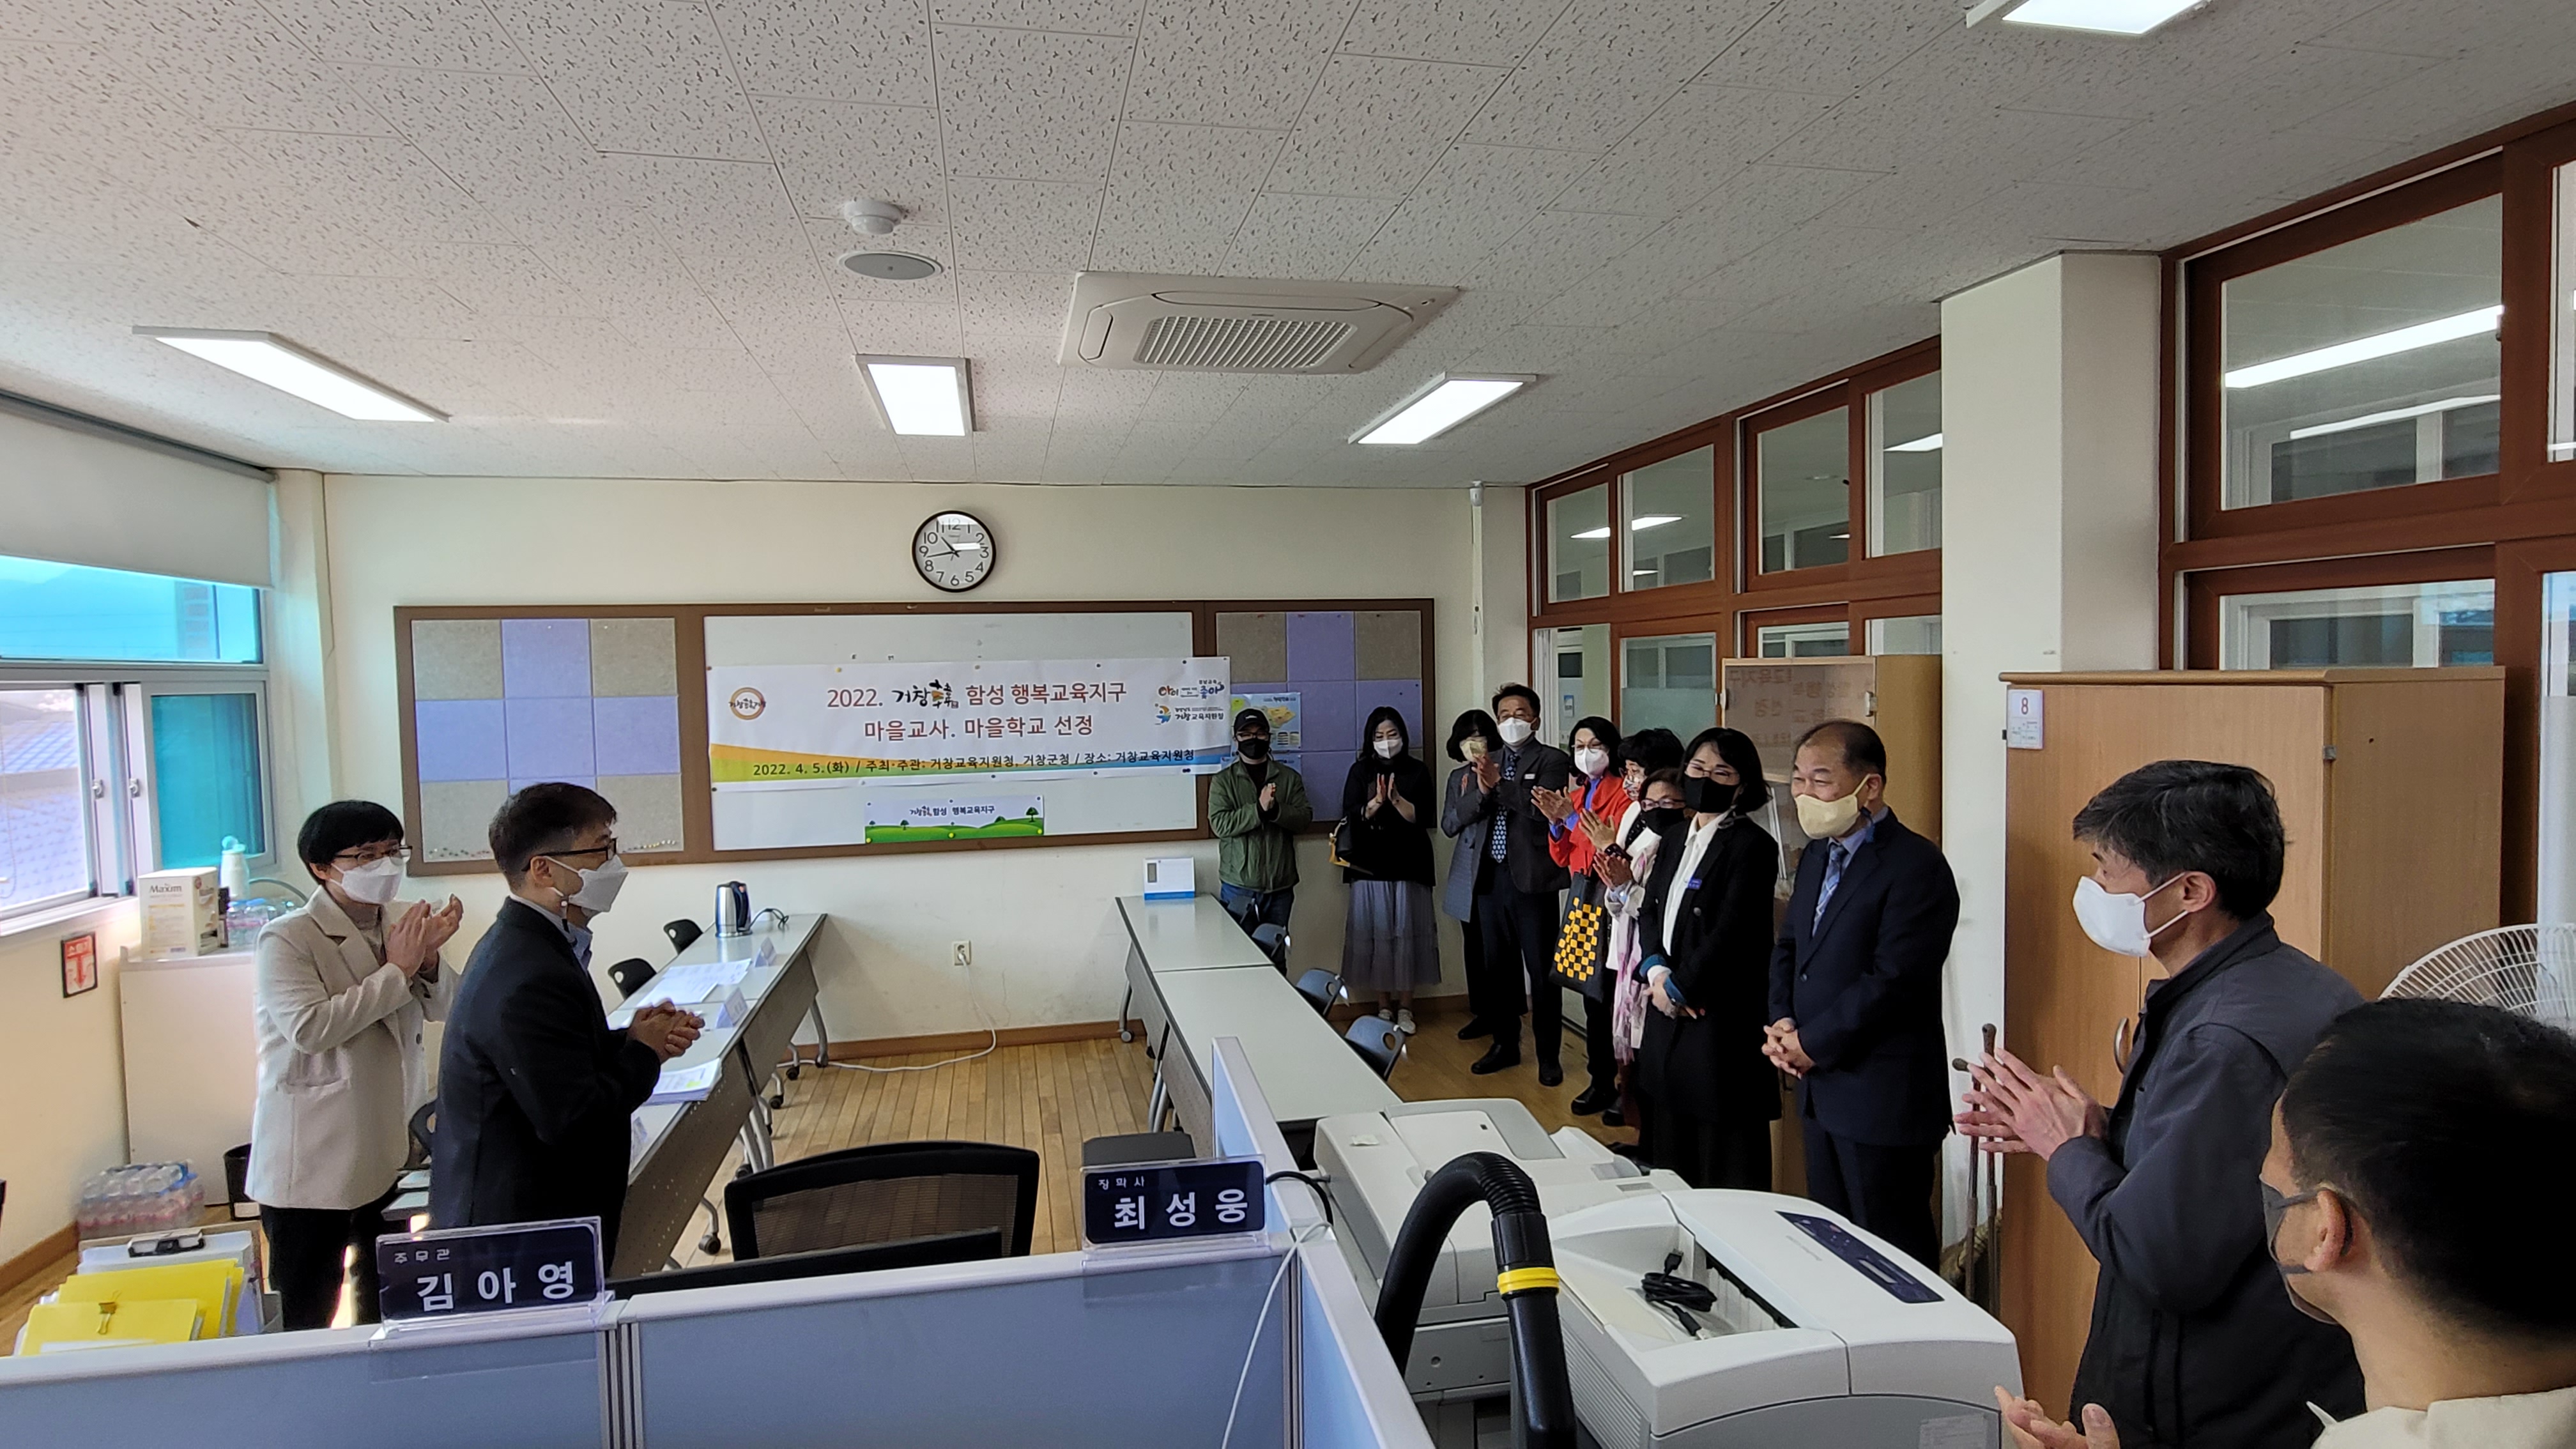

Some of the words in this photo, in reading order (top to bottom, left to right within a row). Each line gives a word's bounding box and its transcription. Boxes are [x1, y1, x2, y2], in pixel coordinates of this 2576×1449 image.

[935, 521, 945, 533] 11
[948, 518, 961, 530] 12
[924, 532, 938, 544] 10
[976, 532, 985, 545] 2
[919, 546, 929, 557] 9
[979, 546, 989, 558] 3
[924, 560, 934, 572] 8
[975, 562, 984, 572] 4
[936, 571, 944, 582] 7
[950, 575, 960, 586] 6
[965, 571, 974, 583] 5
[827, 689, 884, 708] 2022.
[966, 684, 1004, 706] 함성
[1011, 682, 1127, 705] 행복교육지구
[2021, 697, 2028, 715] 8
[1174, 712, 1224, 721] 거창교육지원청
[965, 717, 1047, 739] 마을학교
[1054, 716, 1094, 737] 선정
[754, 763, 790, 776] 2022.
[795, 763, 808, 774] 4.
[813, 758, 850, 774] 5.(화)
[855, 760, 861, 773] /
[1023, 753, 1070, 767] 거창군청
[1075, 753, 1080, 765] /
[1084, 752, 1112, 765] 장소:
[1116, 749, 1194, 763] 거창교육지원청
[933, 807, 947, 816] 함성
[952, 805, 995, 816] 행복교육지구
[1114, 1189, 1248, 1230] 최성웅
[394, 1248, 450, 1264] 주무관
[417, 1261, 574, 1312] 김아영
